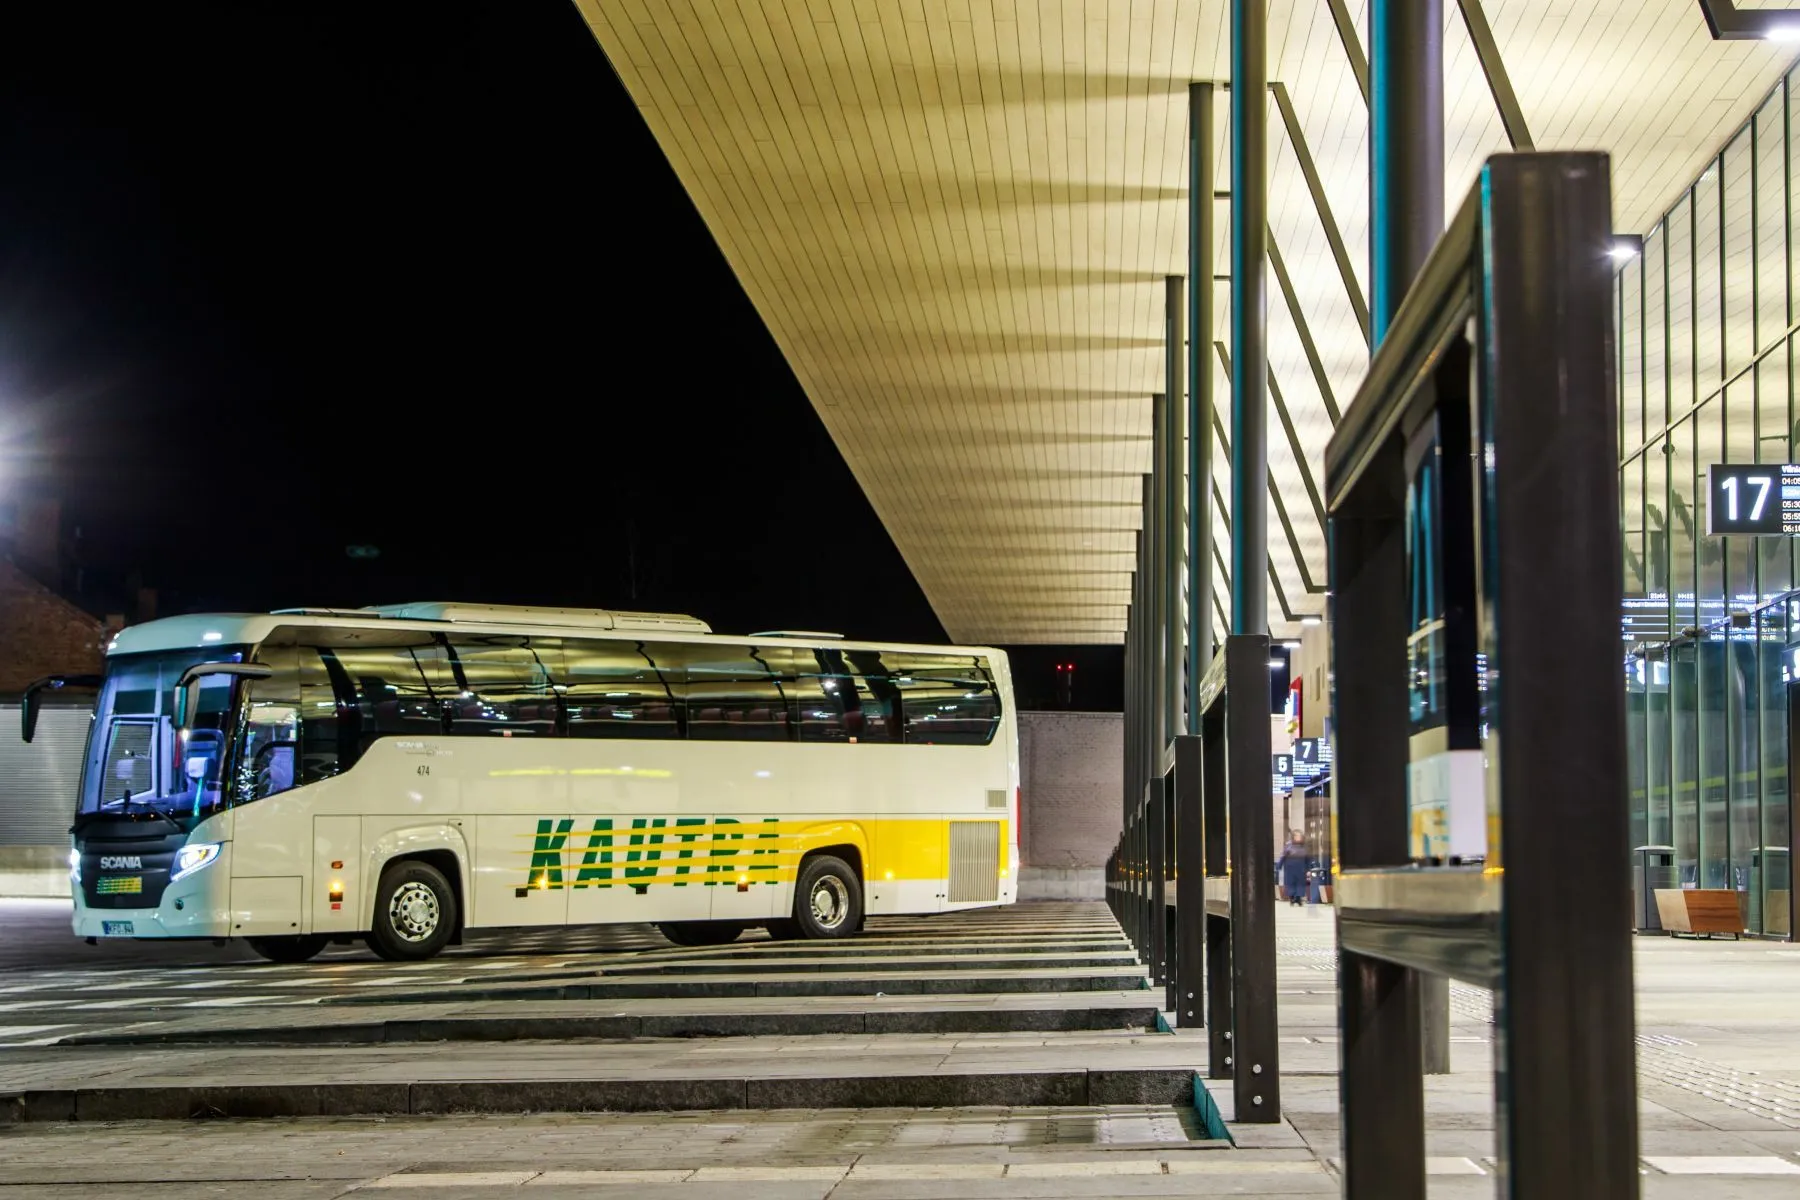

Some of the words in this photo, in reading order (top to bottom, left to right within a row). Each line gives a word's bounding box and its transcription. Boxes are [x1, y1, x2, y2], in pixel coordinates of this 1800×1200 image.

[1722, 476, 1772, 521] 17
[1301, 741, 1312, 759] 7
[417, 765, 430, 776] 474
[100, 856, 142, 869] SCANIA
[527, 818, 780, 890] KAUTRA
